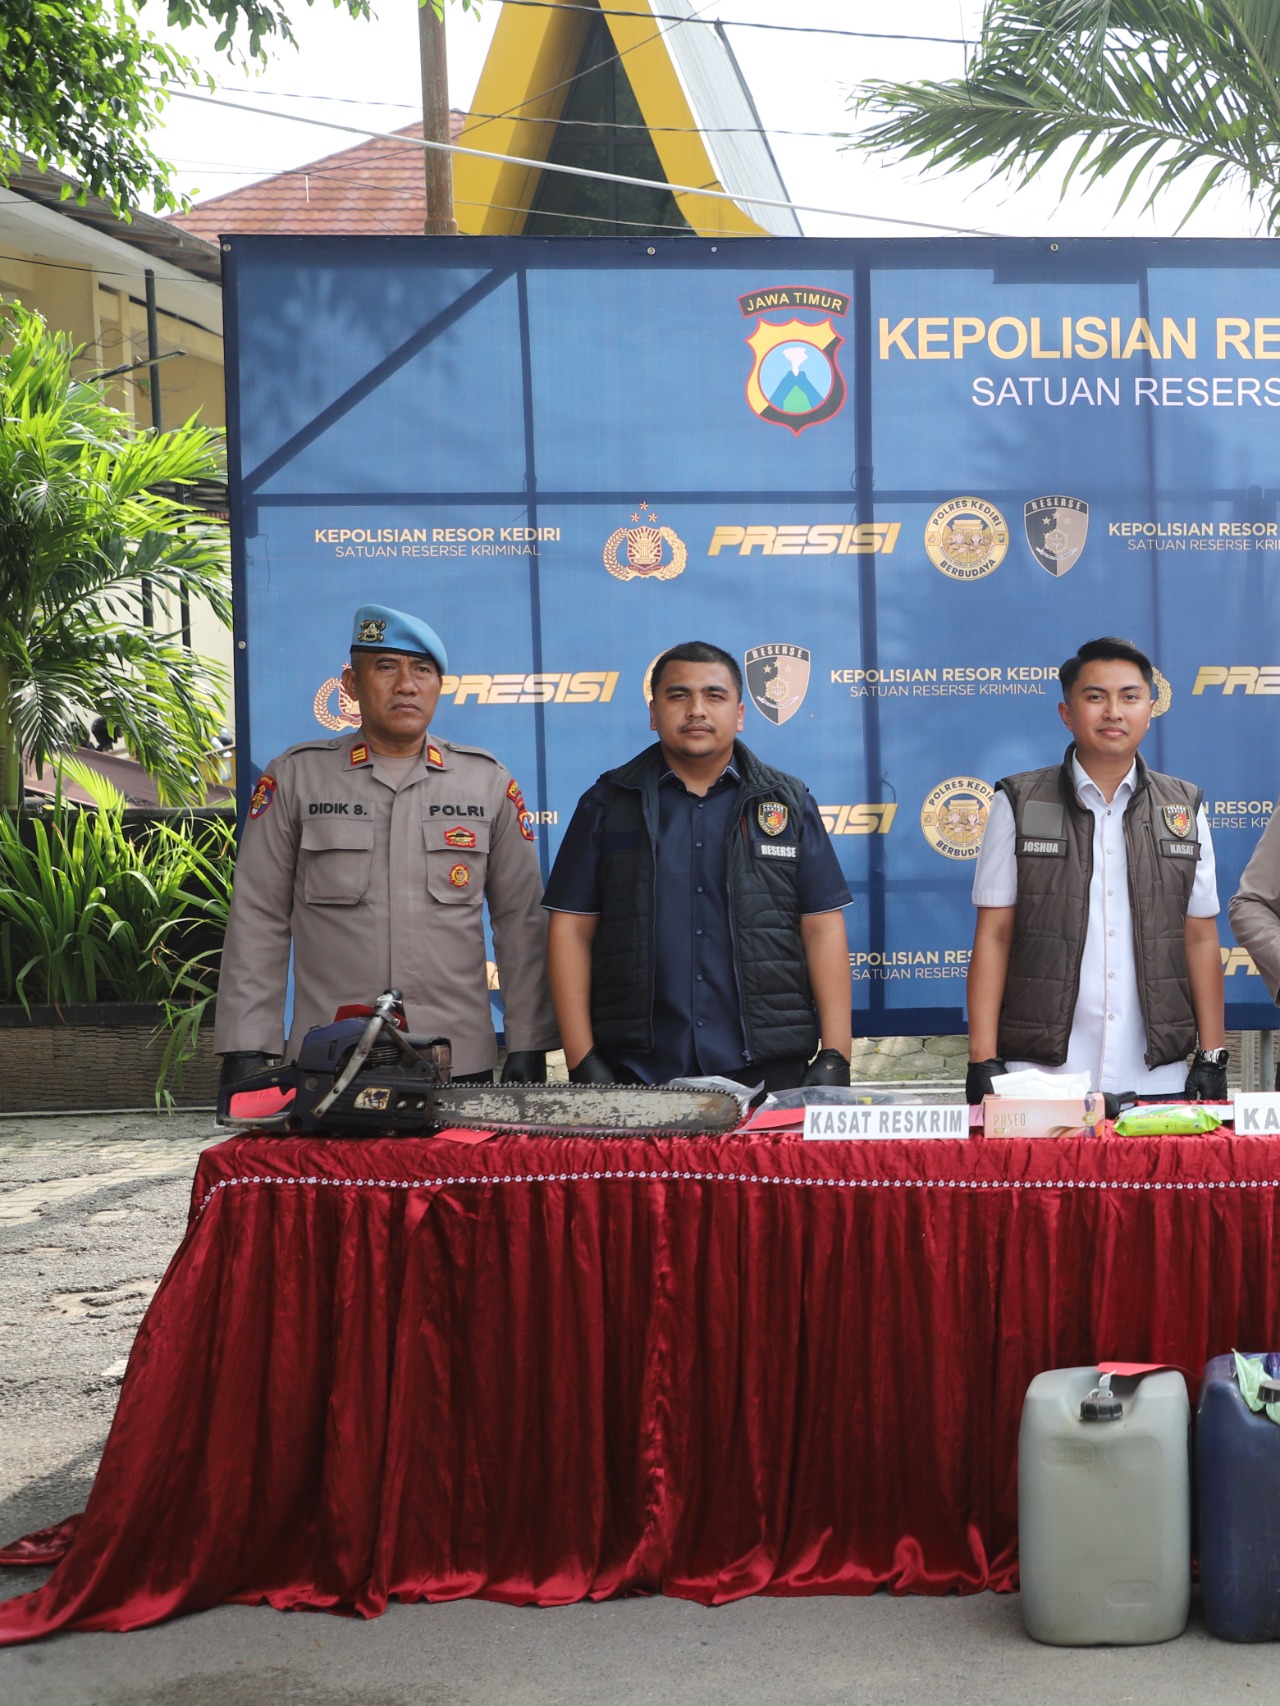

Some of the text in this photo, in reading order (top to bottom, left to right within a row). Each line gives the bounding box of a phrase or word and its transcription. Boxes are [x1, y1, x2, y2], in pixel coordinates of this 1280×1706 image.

[746, 292, 843, 313] JAWA TIMUR
[879, 315, 1197, 361] KEPOLISIAN
[972, 376, 1121, 407] SATUAN
[1032, 497, 1082, 510] RESERSE
[933, 500, 1002, 526] POLRES KEDIRI
[315, 527, 561, 543] KEPOLISIAN RESOR KEDIRI
[1108, 522, 1213, 536] KEPOLISIAN
[1218, 522, 1278, 536] RESOR
[707, 522, 902, 556] PRESISI
[1128, 539, 1186, 550] SATUAN
[1190, 539, 1251, 550] RESERSE
[335, 544, 541, 558] SATUAN RESERSE KRIMINAL
[940, 558, 997, 577] BERBUDAYA
[752, 646, 803, 660] RESERSE
[830, 666, 1060, 683] KEPOLISIAN RESOR KEDIR
[850, 683, 1046, 698] SATUAN RESERSE KRIMINAL
[928, 780, 994, 806] POLRES KEDIR
[308, 802, 368, 816] DIDIK S.
[429, 805, 484, 817] POLRI
[760, 844, 796, 858] RESERSE
[936, 840, 981, 857] BERBUDA
[1023, 841, 1059, 854] JOSHUA
[1170, 843, 1194, 856] KASAT
[849, 951, 939, 966] EPOLISIAN
[852, 967, 968, 980] SATUAN RESERS
[810, 1109, 963, 1134] KASAT RESKRIM
